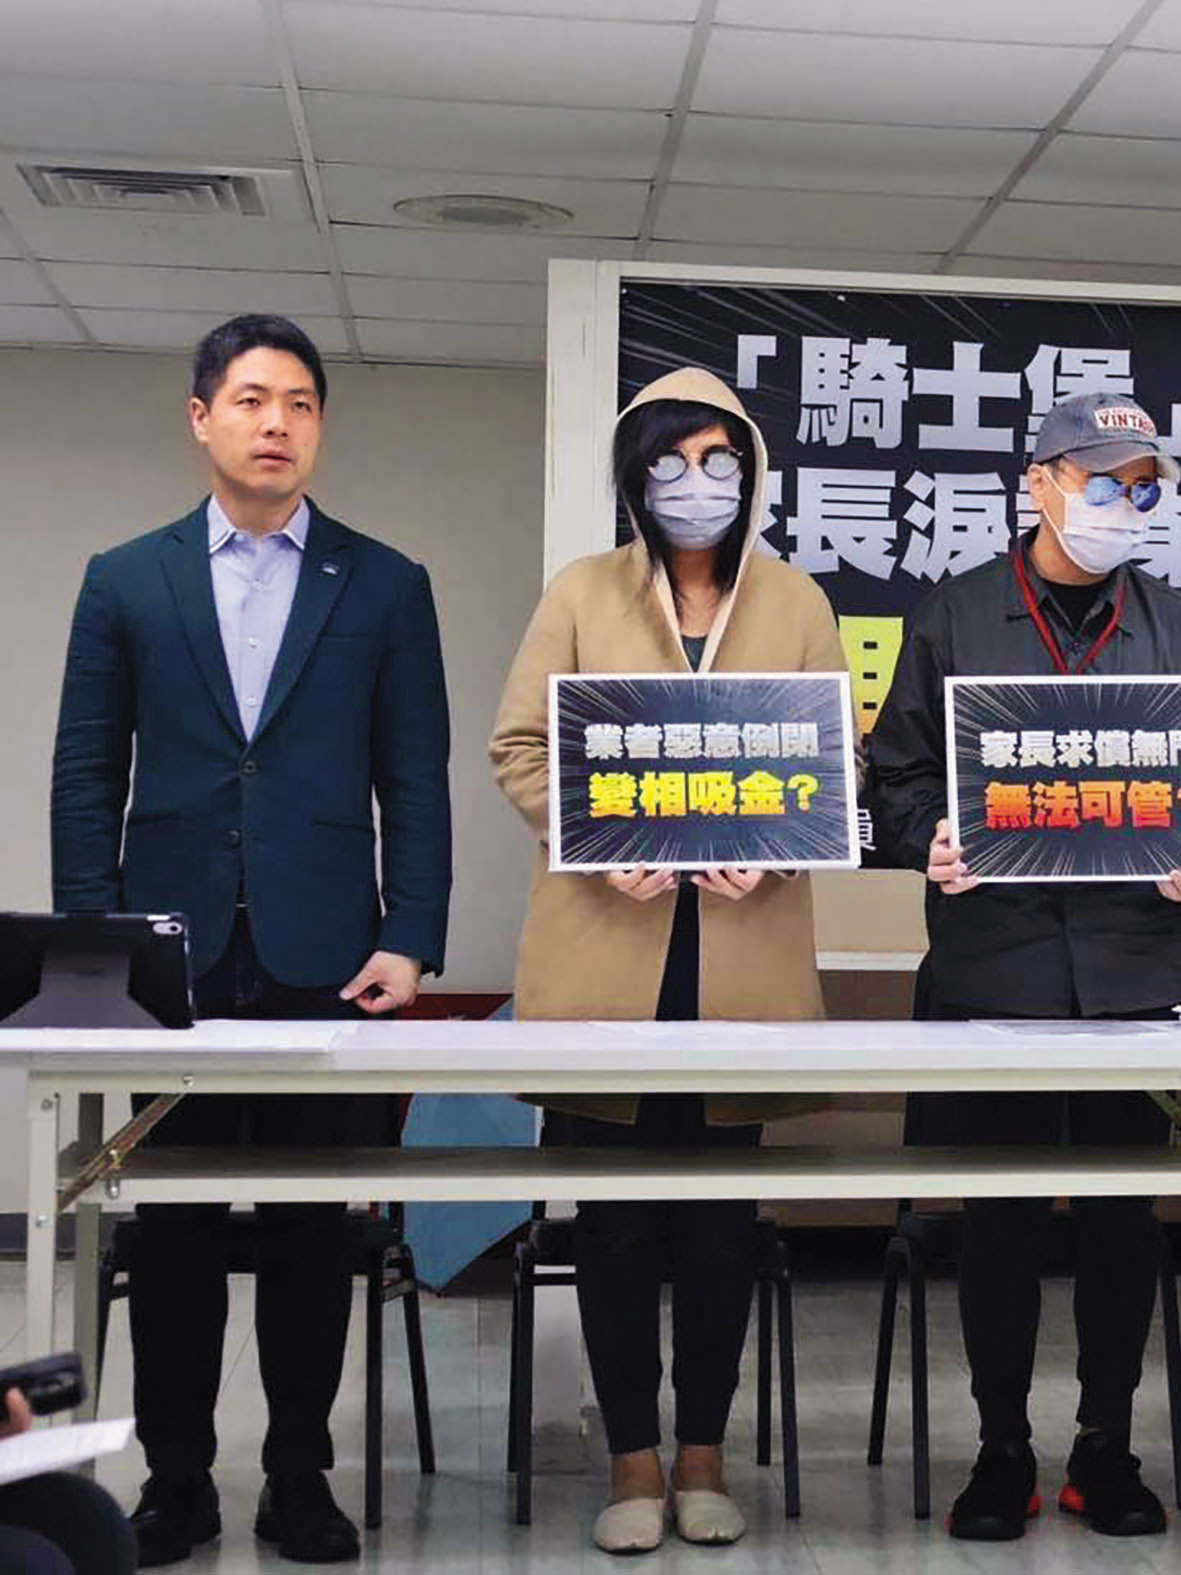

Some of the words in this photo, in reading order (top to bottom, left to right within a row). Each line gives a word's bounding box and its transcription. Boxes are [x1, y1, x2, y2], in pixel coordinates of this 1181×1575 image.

[584, 722, 819, 759] 業者惡意倒閉
[589, 771, 820, 818] 變相吸金？
